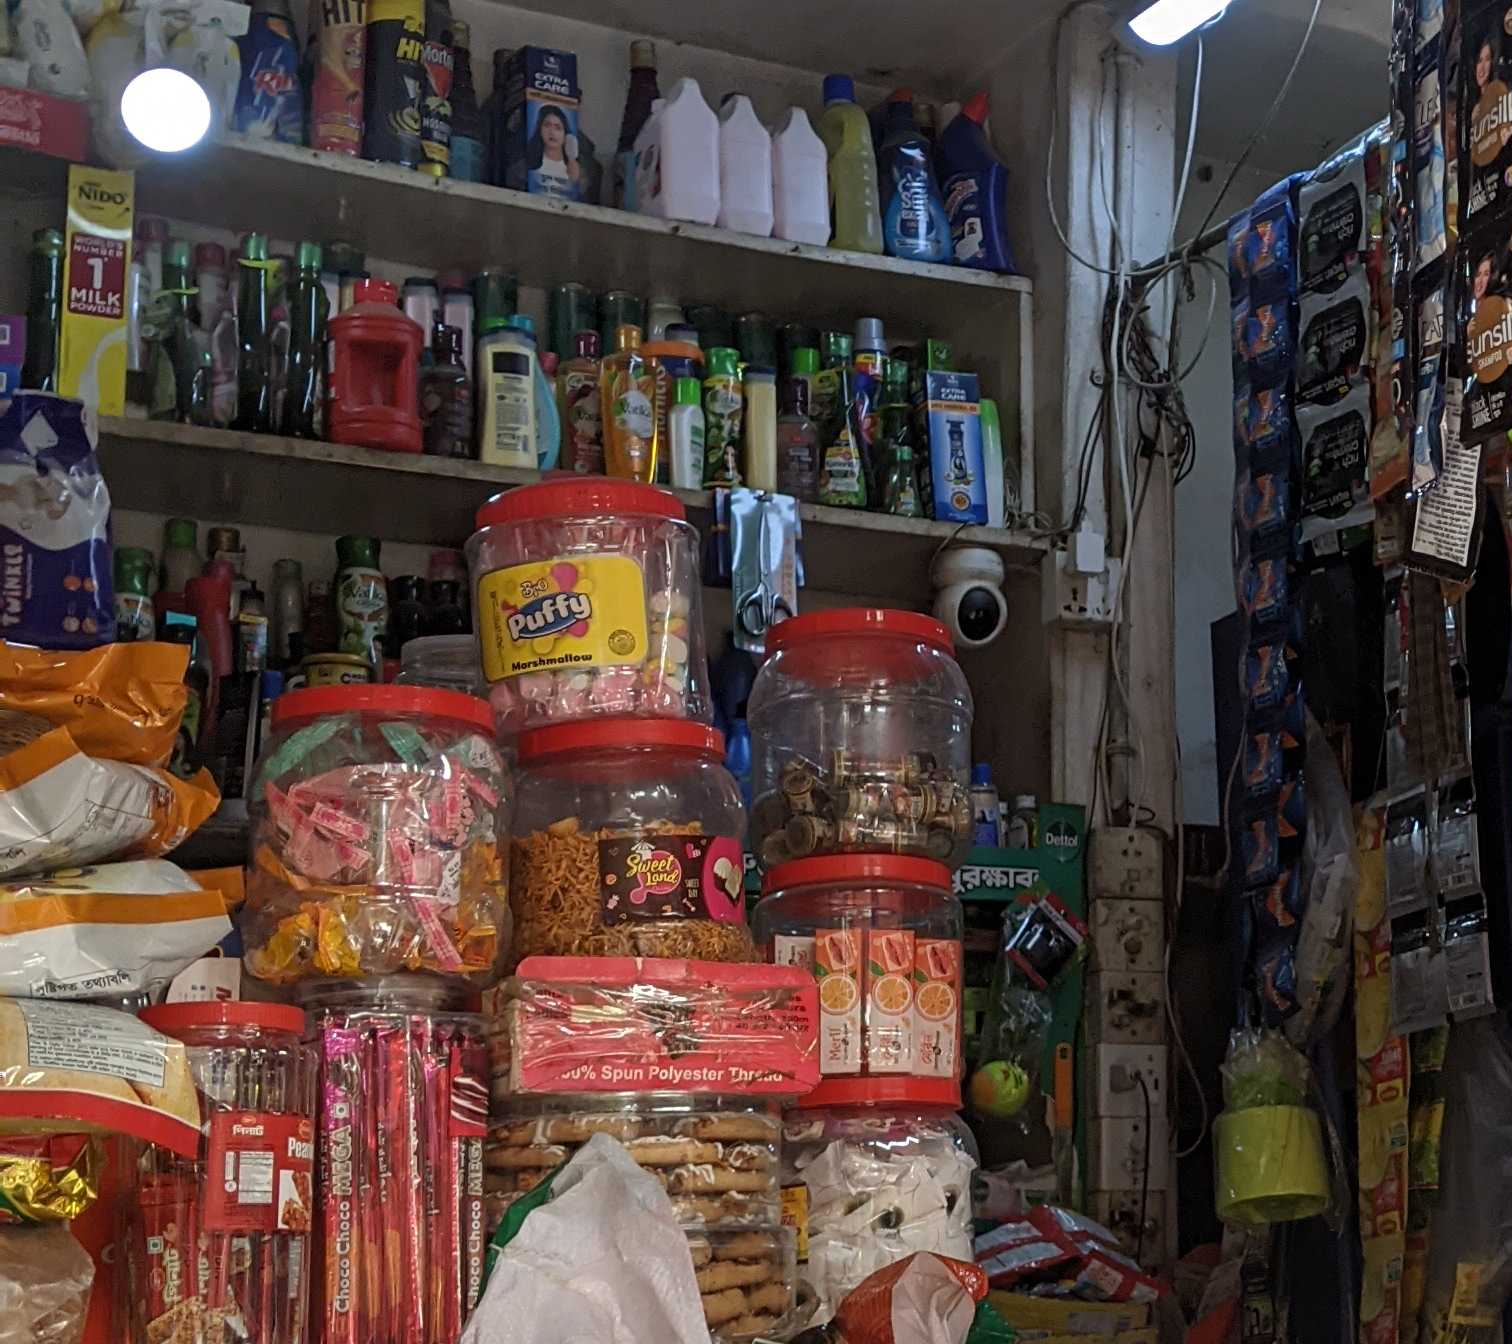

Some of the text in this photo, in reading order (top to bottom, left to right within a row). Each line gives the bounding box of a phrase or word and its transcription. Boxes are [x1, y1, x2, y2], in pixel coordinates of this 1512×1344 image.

[397, 37, 423, 60] HI
[534, 73, 568, 86] EXTRA
[534, 82, 568, 95] CARE
[78, 185, 124, 204] NIDO
[73, 245, 123, 256] NUMBER
[87, 258, 103, 289] 1
[71, 288, 121, 305] MILK
[70, 304, 121, 316] POWDER
[941, 394, 966, 402] CARE
[1342, 448, 1359, 466] rich
[507, 592, 593, 641] Puffy
[512, 653, 593, 672] Marshmallow
[1045, 833, 1078, 847] Dettol
[627, 853, 674, 877] Sweet
[646, 868, 678, 886] Land
[555, 1064, 784, 1085] 00% Spun Polyester Thread
[330, 1124, 352, 1313] Choco Choco MEGA
[468, 1200, 481, 1253] Choco
